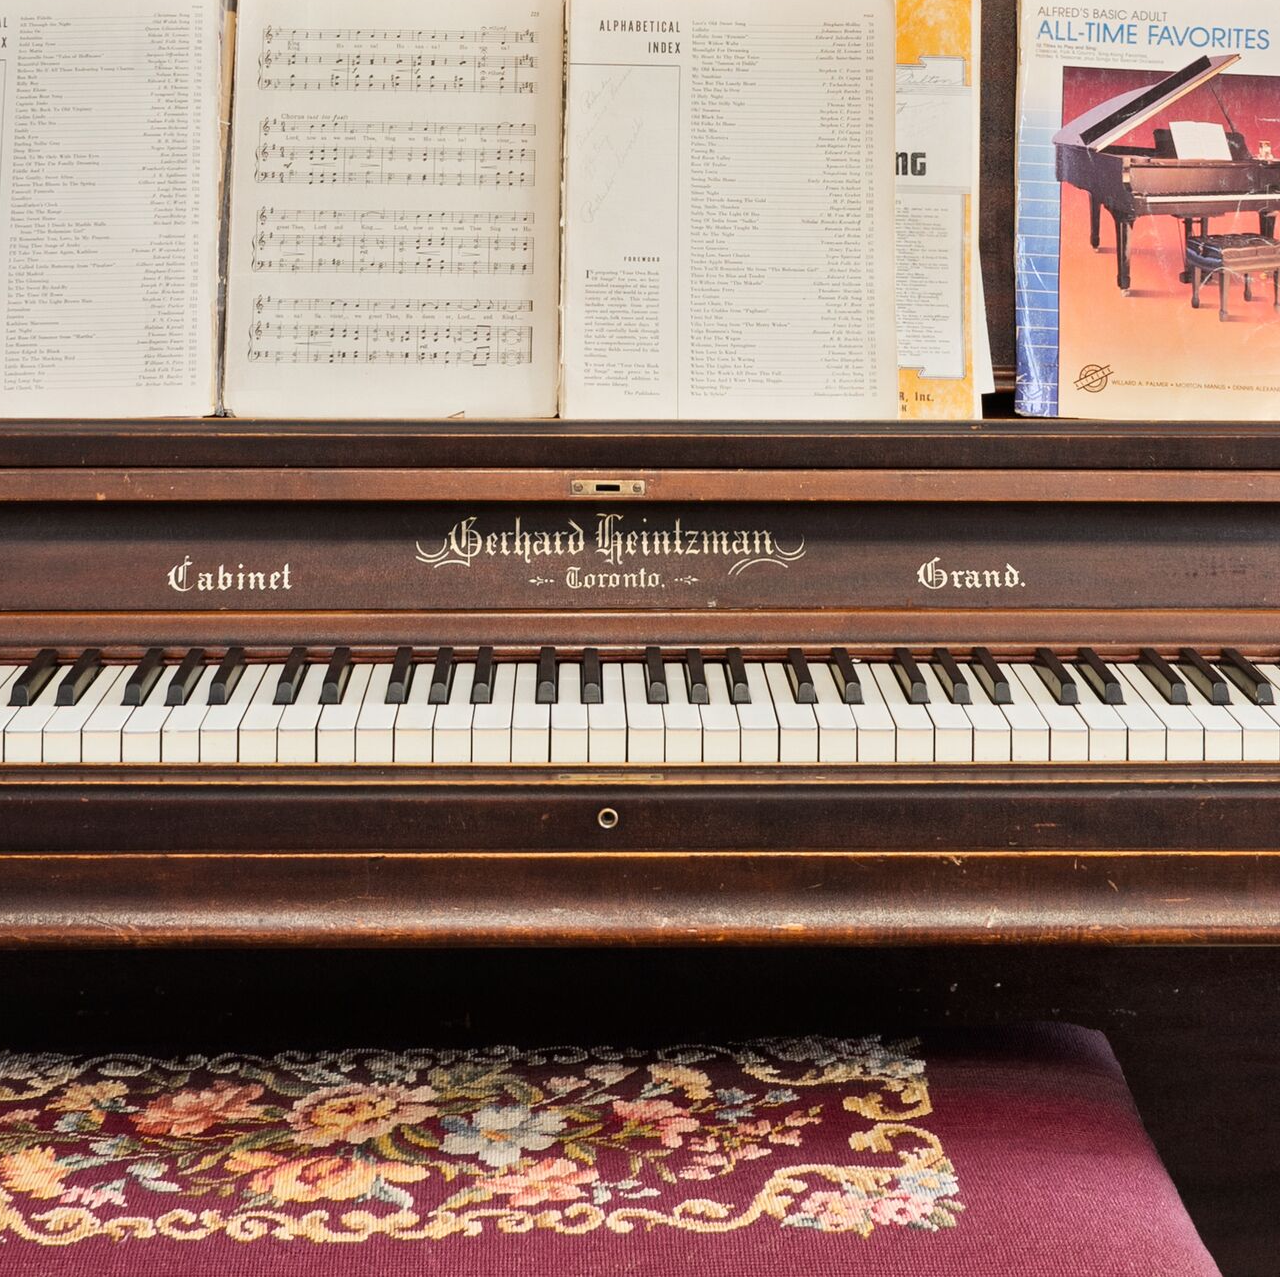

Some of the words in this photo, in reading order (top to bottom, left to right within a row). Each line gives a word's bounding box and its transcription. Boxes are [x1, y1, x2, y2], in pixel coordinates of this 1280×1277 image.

[1038, 6, 1090, 19] ALFRED'S
[1092, 10, 1128, 20] BASIC
[1132, 10, 1167, 21] ADULT
[599, 20, 681, 33] ALPHABETICAL
[1037, 20, 1138, 44] ALL-TIME
[1148, 26, 1270, 50] FAVORITES
[648, 41, 681, 54] INDEX
[914, 390, 935, 403] Inc.
[448, 516, 585, 567] Gerhard
[596, 513, 775, 565] Heintzman
[167, 554, 292, 592] Cabinet
[566, 567, 665, 589] Toronto.
[917, 556, 1026, 590] Grand.
